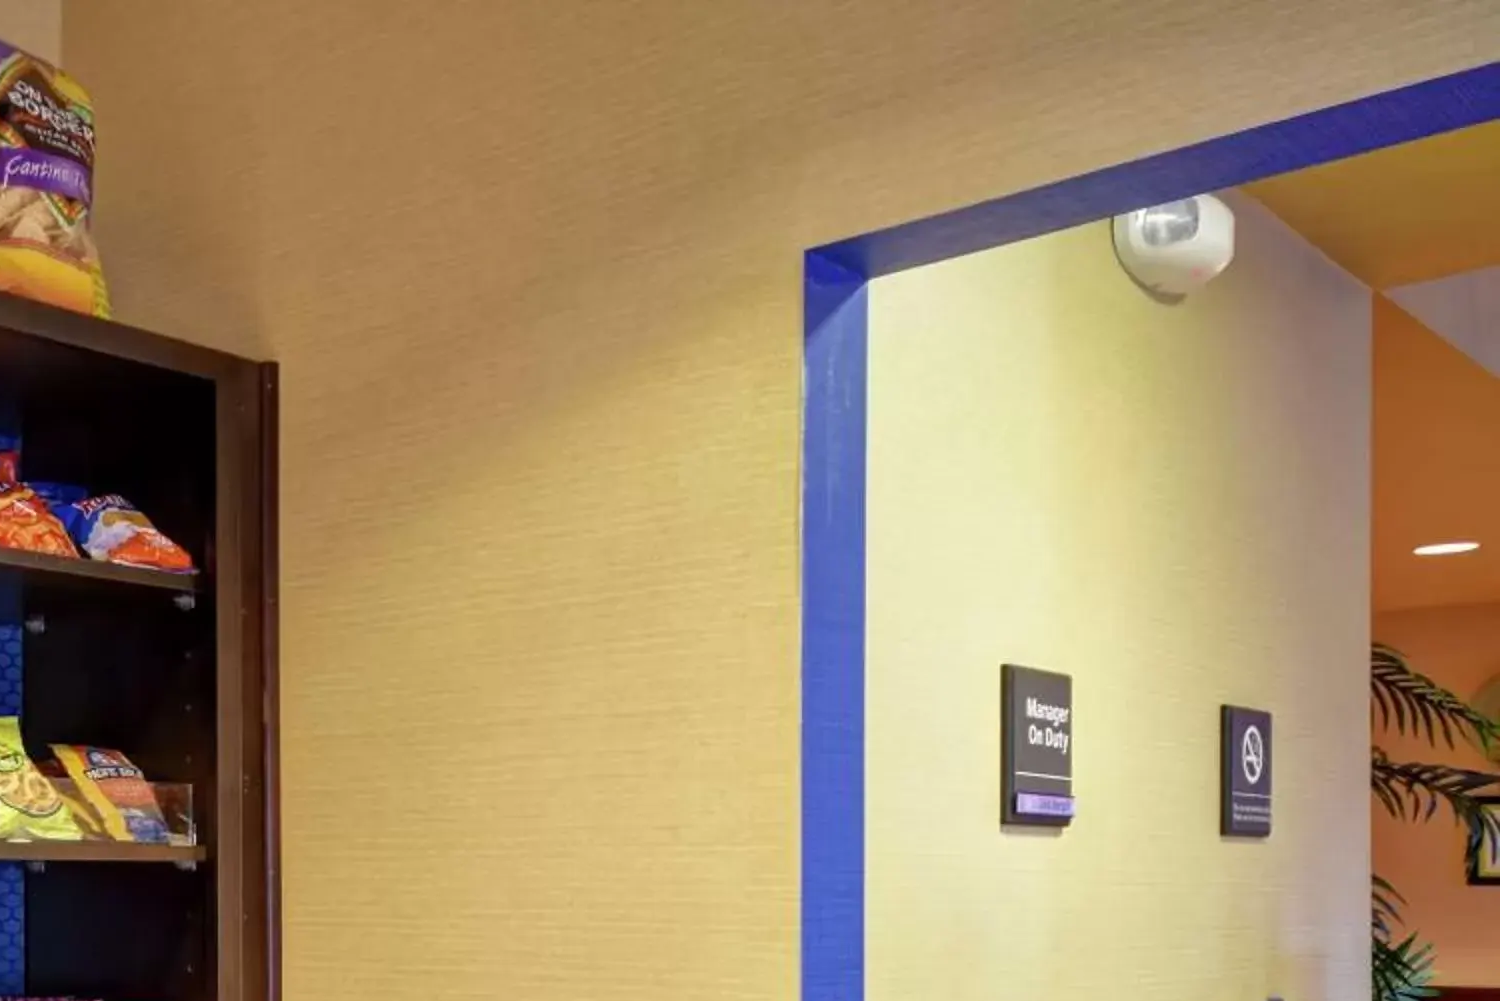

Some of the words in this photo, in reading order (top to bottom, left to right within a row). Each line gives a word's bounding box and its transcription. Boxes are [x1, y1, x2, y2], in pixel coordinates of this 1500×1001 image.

[1026, 696, 1069, 727] Manager
[1028, 724, 1043, 745] On
[1045, 727, 1069, 755] Duty
